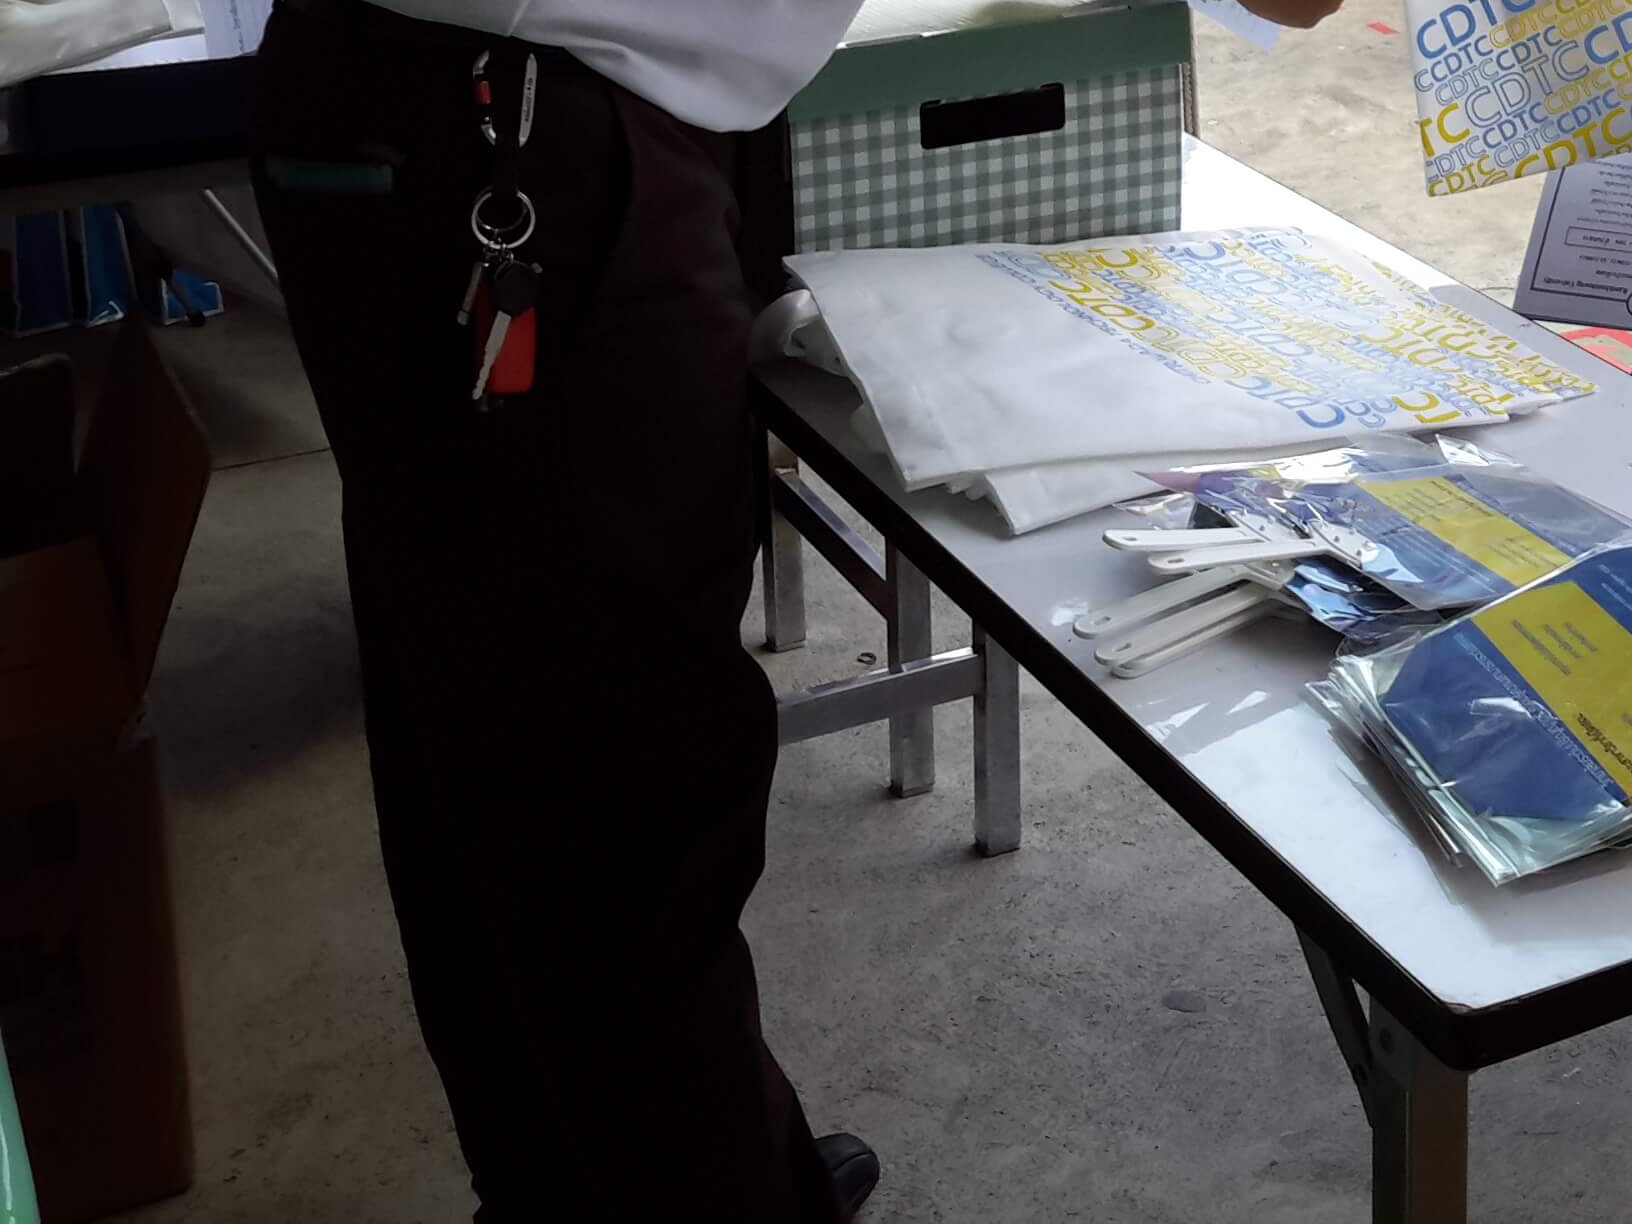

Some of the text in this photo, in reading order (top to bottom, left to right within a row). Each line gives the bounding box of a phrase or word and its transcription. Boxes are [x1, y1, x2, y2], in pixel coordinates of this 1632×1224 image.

[1428, 33, 1495, 81] CDTC
[1433, 56, 1501, 105] CDTC
[1495, 23, 1564, 72] CDTC
[1463, 37, 1593, 128] CDTC
[1481, 100, 1550, 148] CDTC
[1492, 118, 1563, 168] CDTC
[1555, 86, 1622, 133] CDTC
[1048, 281, 1156, 329] CDTC
